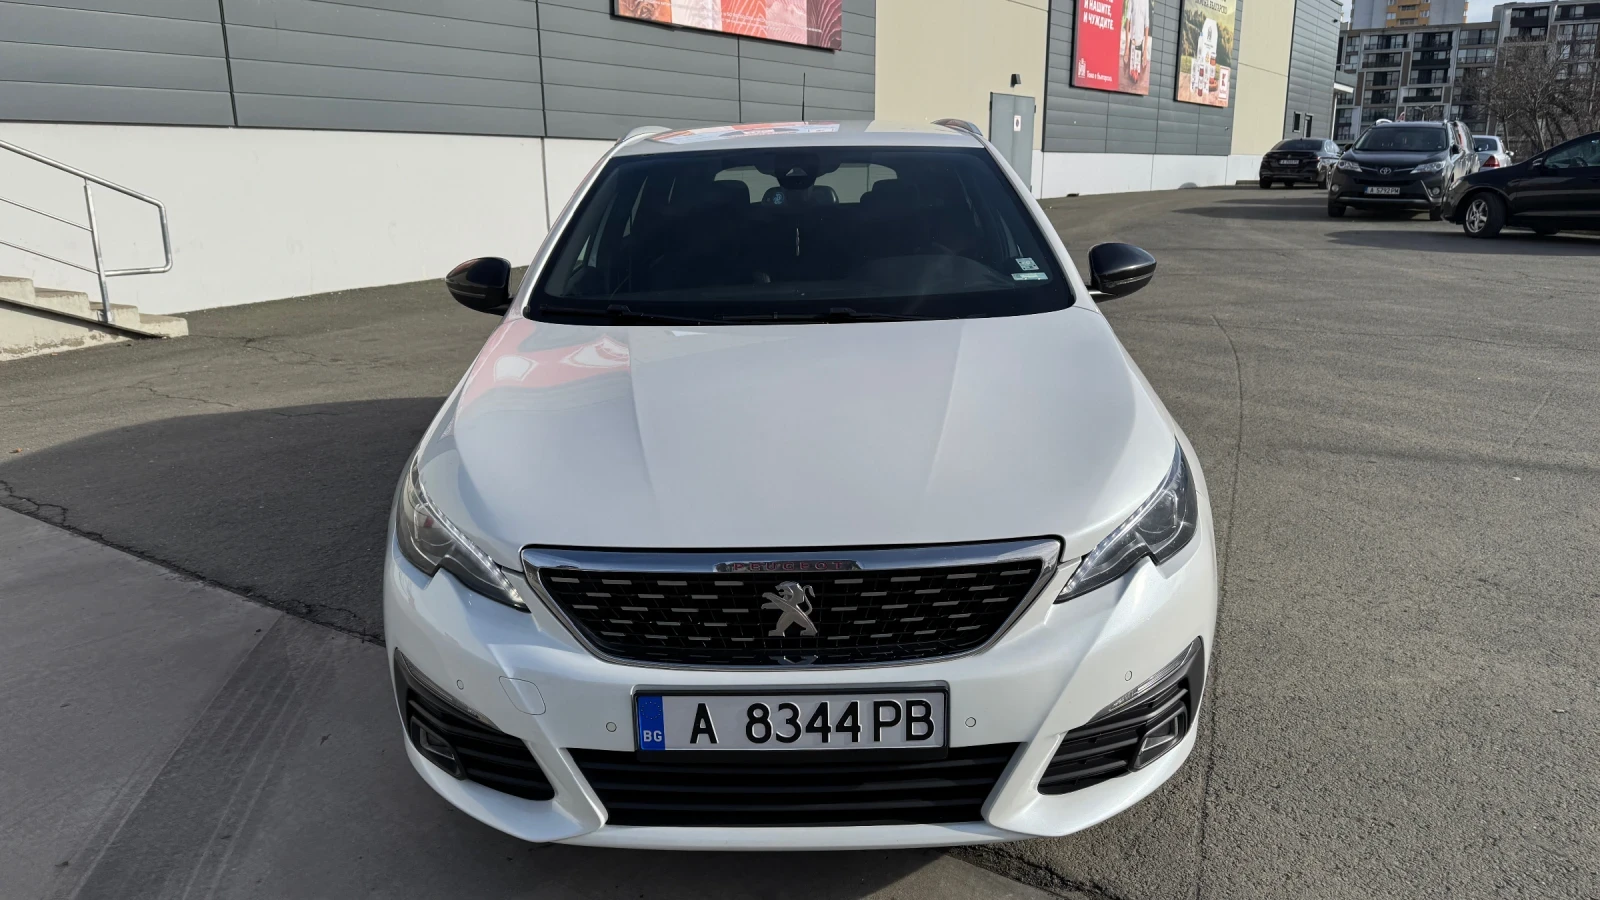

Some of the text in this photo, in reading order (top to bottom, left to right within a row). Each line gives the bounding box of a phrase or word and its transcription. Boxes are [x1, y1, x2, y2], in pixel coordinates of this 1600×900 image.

[1089, 0, 1112, 17] НАШИТЕ,
[1083, 11, 1115, 30] И ЧУЖДИТЕ.
[733, 561, 843, 571] PEUGEOT
[689, 698, 935, 744] A 8344 PB
[643, 730, 663, 743] BG
